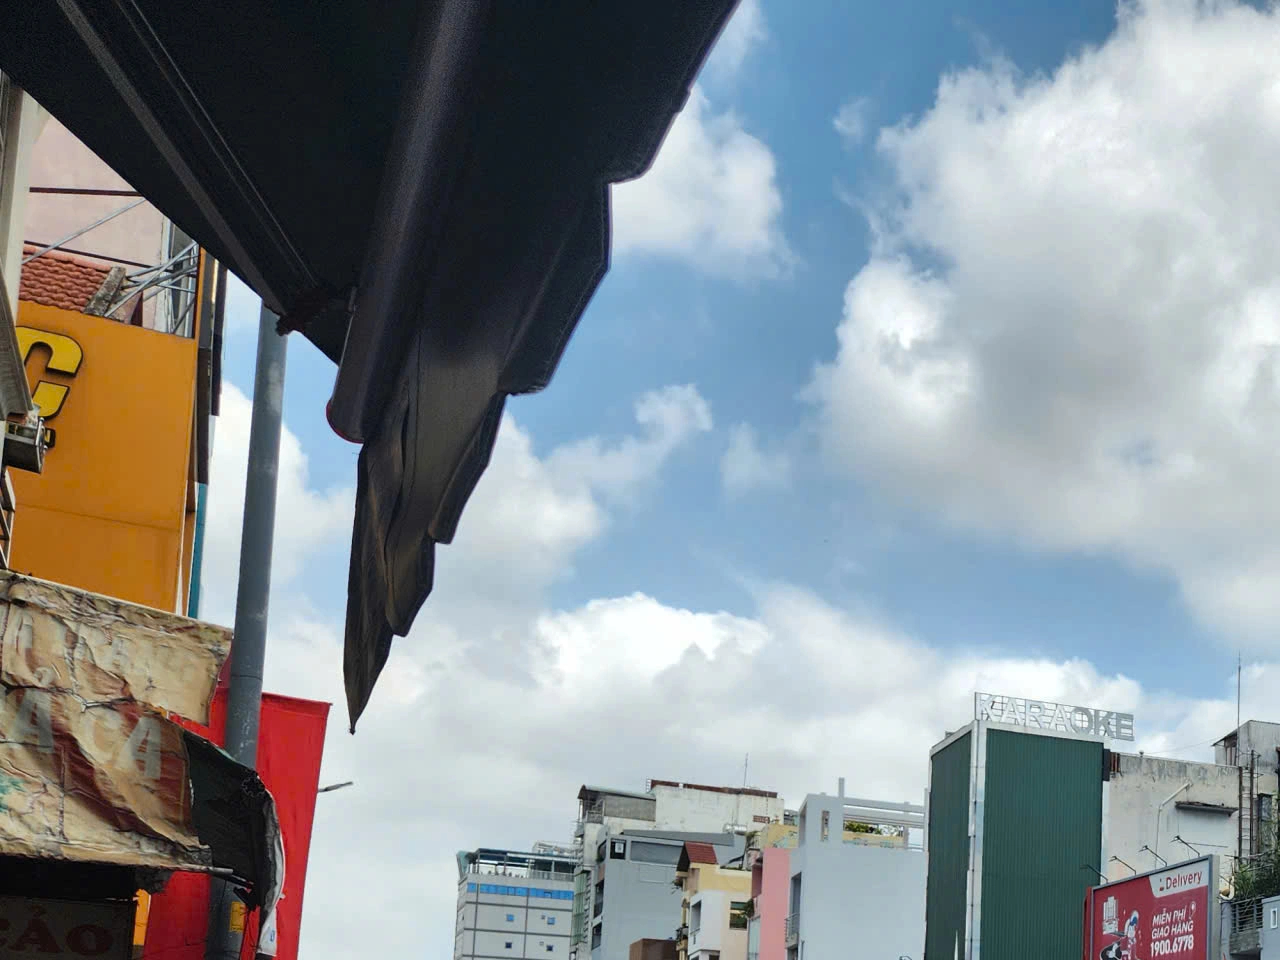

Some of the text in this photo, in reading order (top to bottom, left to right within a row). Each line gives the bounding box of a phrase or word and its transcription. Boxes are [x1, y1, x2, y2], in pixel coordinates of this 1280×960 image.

[976, 692, 1135, 742] KARAOKE
[1165, 871, 1202, 890] Delivery
[1152, 904, 1187, 926] MIỄN PHÍ
[1151, 926, 1170, 940] GIAO
[1150, 934, 1195, 957] 1900.6778
